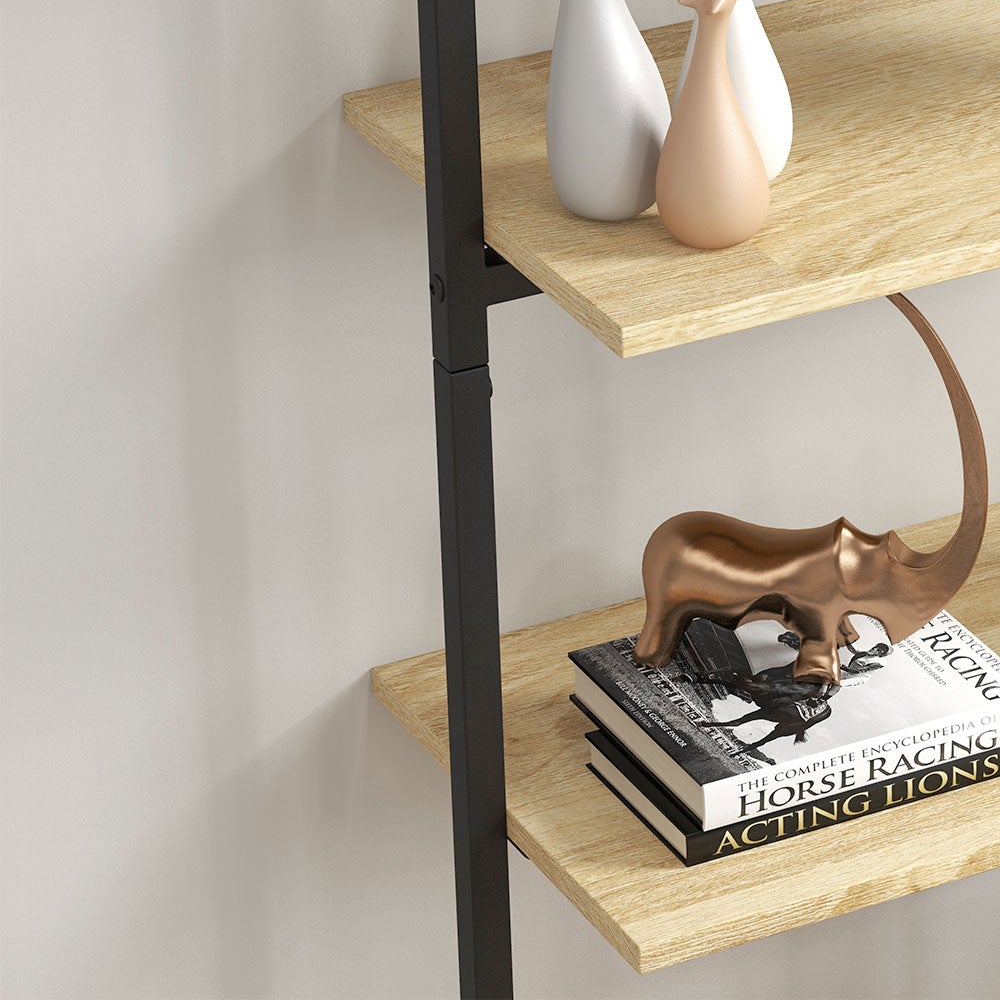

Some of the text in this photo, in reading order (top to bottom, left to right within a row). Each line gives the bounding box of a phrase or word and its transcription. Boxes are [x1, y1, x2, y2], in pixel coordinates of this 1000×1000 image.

[648, 713, 671, 731] GEORGE
[737, 776, 769, 793] THE
[774, 752, 856, 782] COMPLETE
[862, 720, 976, 758] ENCYCLOPEDIA
[712, 753, 1000, 857] ACTING LIONS
[738, 729, 998, 819] HORSE RACING
